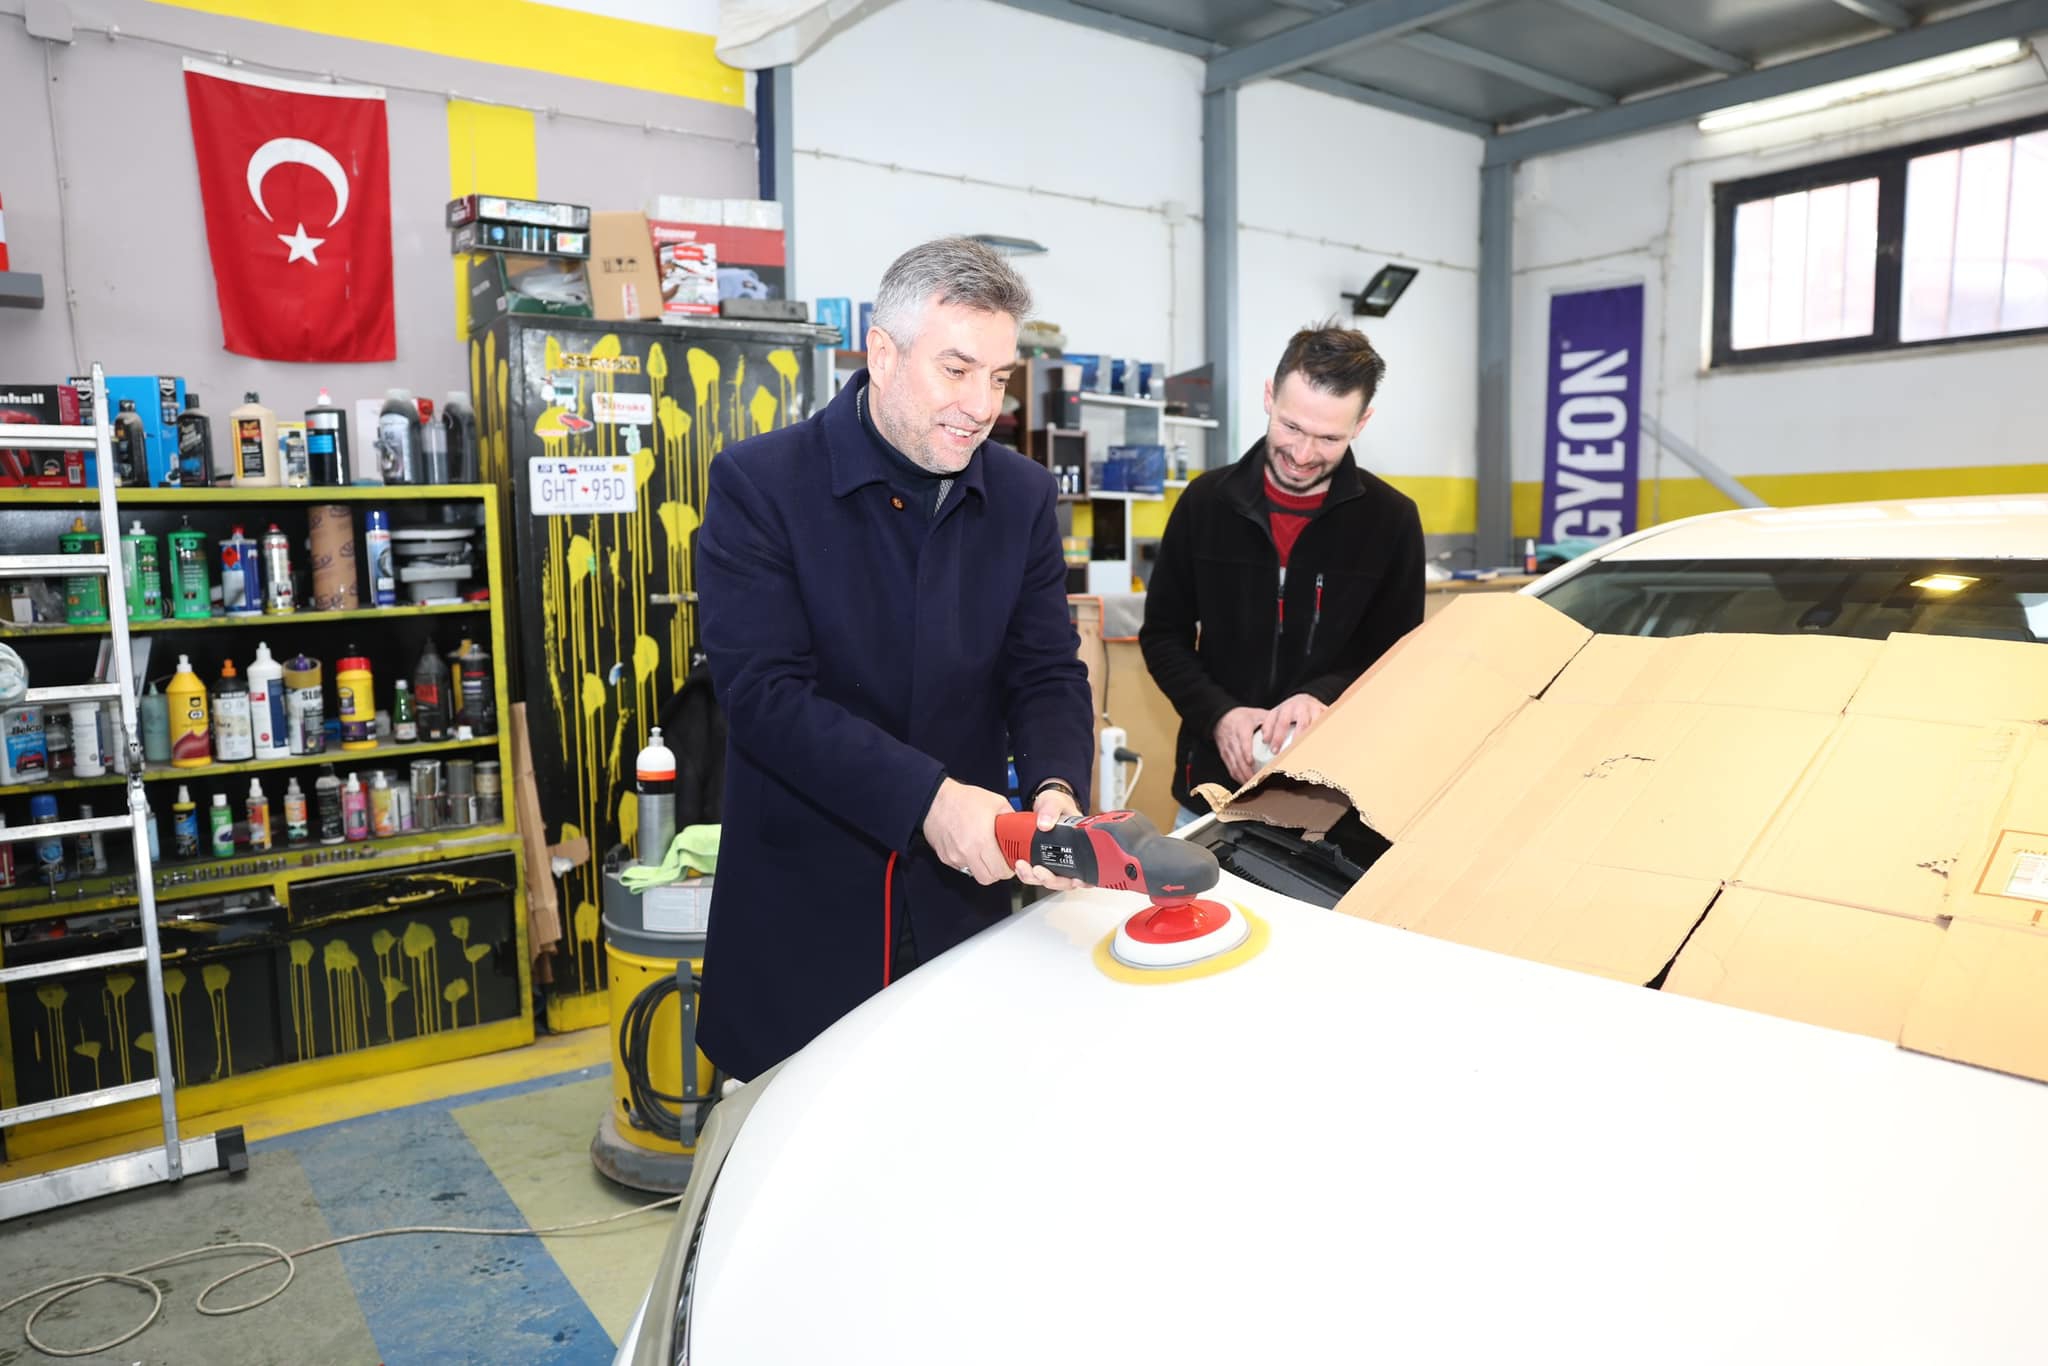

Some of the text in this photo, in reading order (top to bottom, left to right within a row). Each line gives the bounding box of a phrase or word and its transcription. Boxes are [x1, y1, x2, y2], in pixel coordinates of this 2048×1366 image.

[1552, 348, 1629, 545] GYEON
[578, 463, 607, 472] TEXAS
[542, 478, 625, 502] GHT 95D
